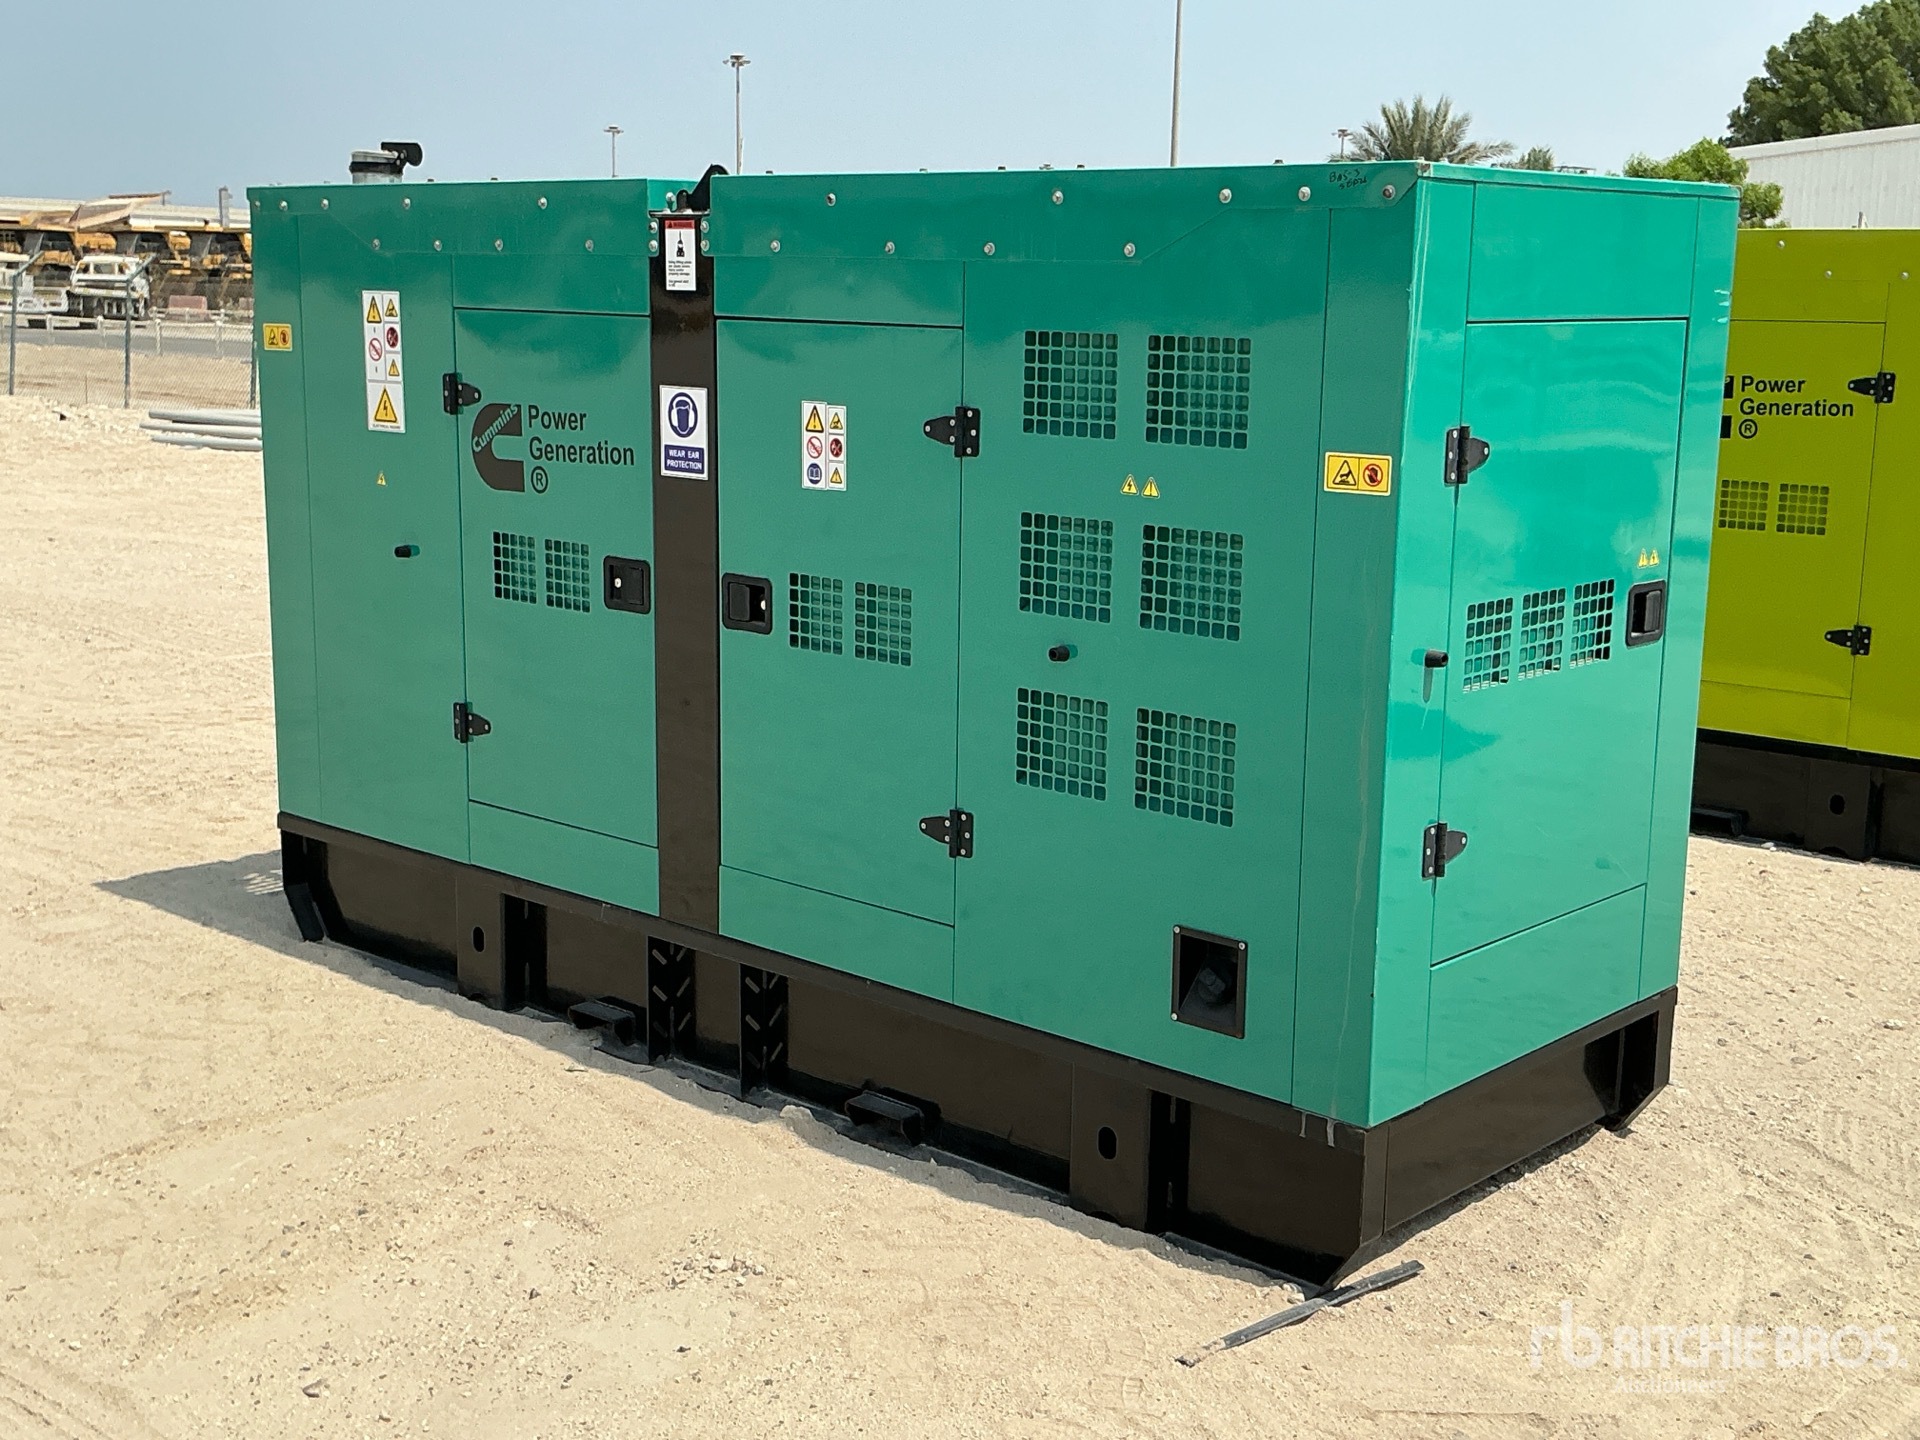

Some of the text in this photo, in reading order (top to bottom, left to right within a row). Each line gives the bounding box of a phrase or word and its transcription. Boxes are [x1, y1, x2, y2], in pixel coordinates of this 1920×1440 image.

[1740, 375, 1806, 393] Power
[1739, 397, 1854, 417] Generation
[528, 404, 587, 431] Power
[472, 404, 519, 453] Cummins
[529, 436, 635, 466] Generation
[669, 449, 700, 460] WEAR EAR
[666, 459, 702, 470] PROTECTION
